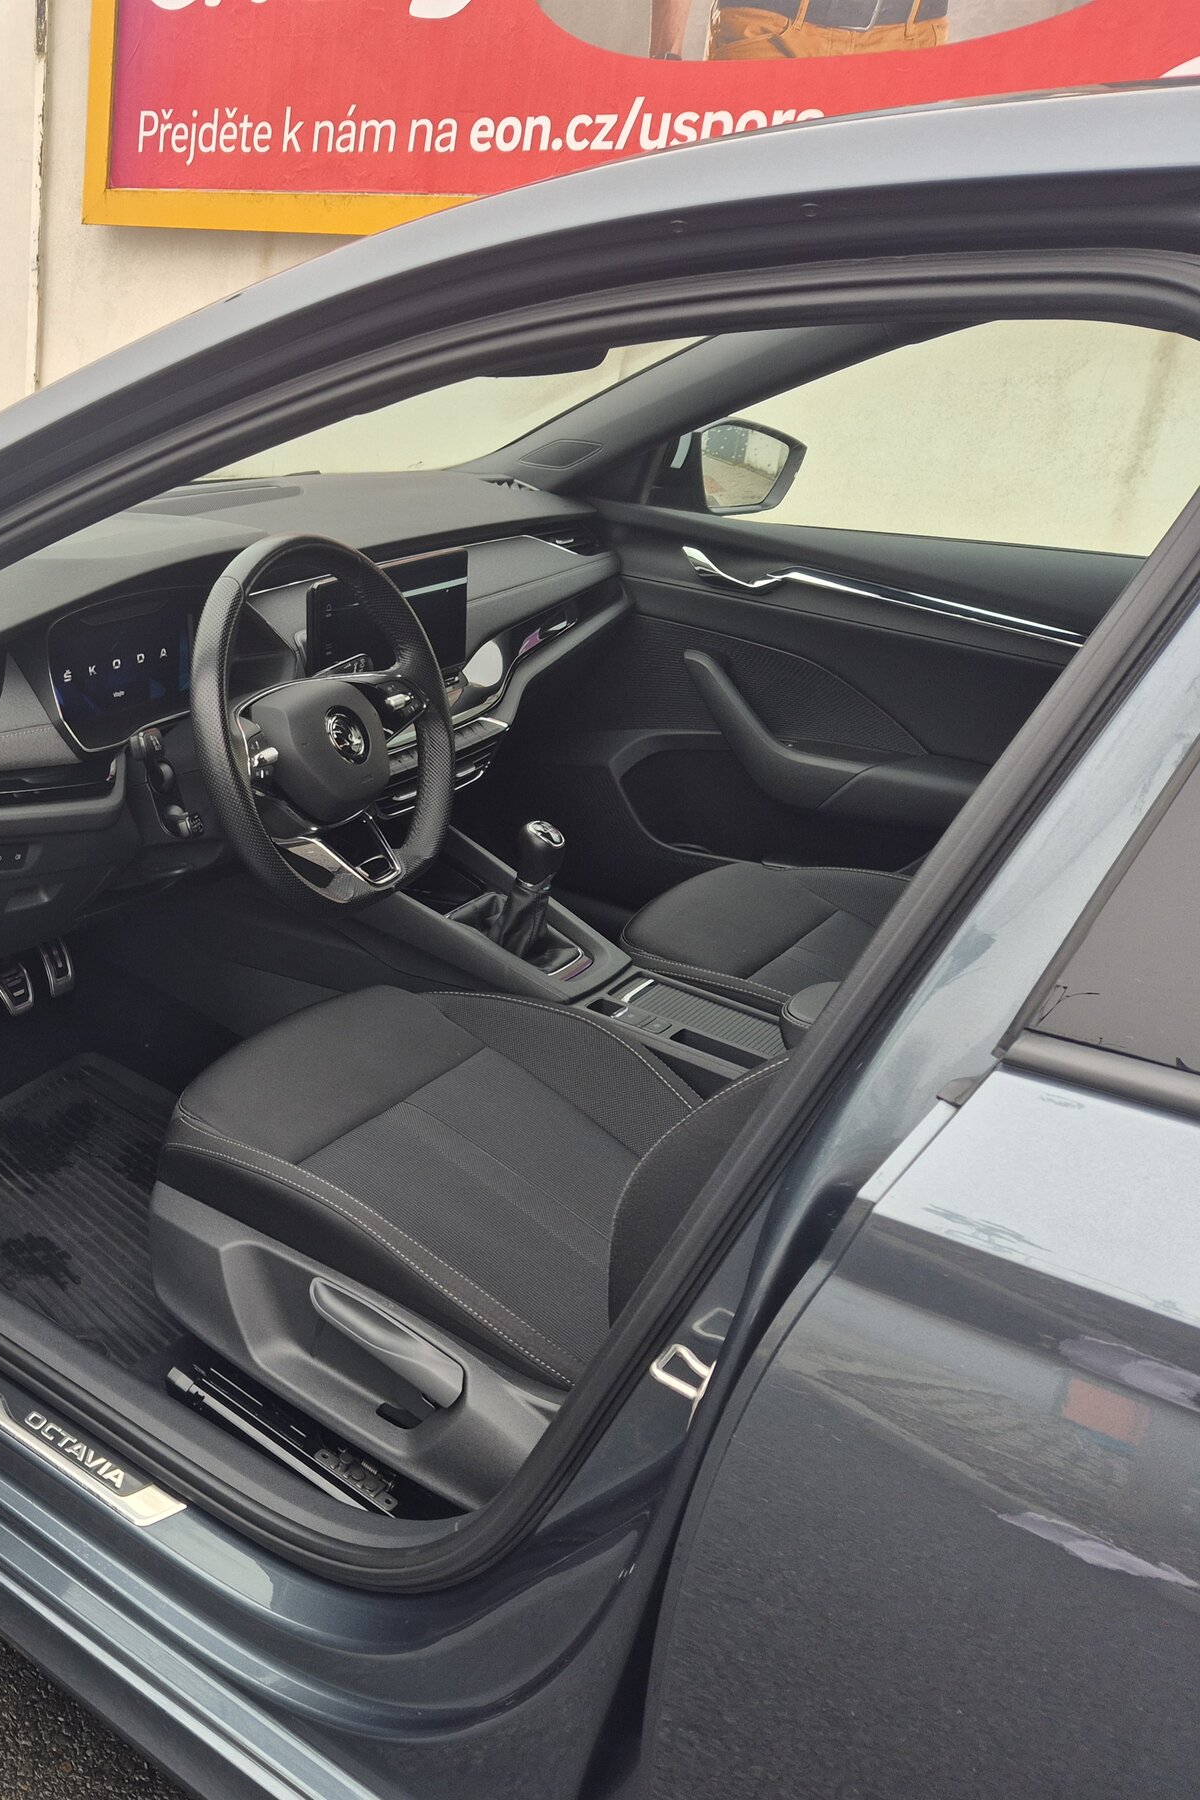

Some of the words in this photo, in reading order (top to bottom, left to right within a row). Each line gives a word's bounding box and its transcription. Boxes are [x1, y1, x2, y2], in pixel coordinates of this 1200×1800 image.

[138, 107, 273, 166] Přejděte
[282, 105, 305, 153] k
[312, 103, 397, 153] nám
[407, 117, 458, 153] na
[63, 648, 168, 683] ŠKODA
[24, 1410, 127, 1489] OCTAVIA
